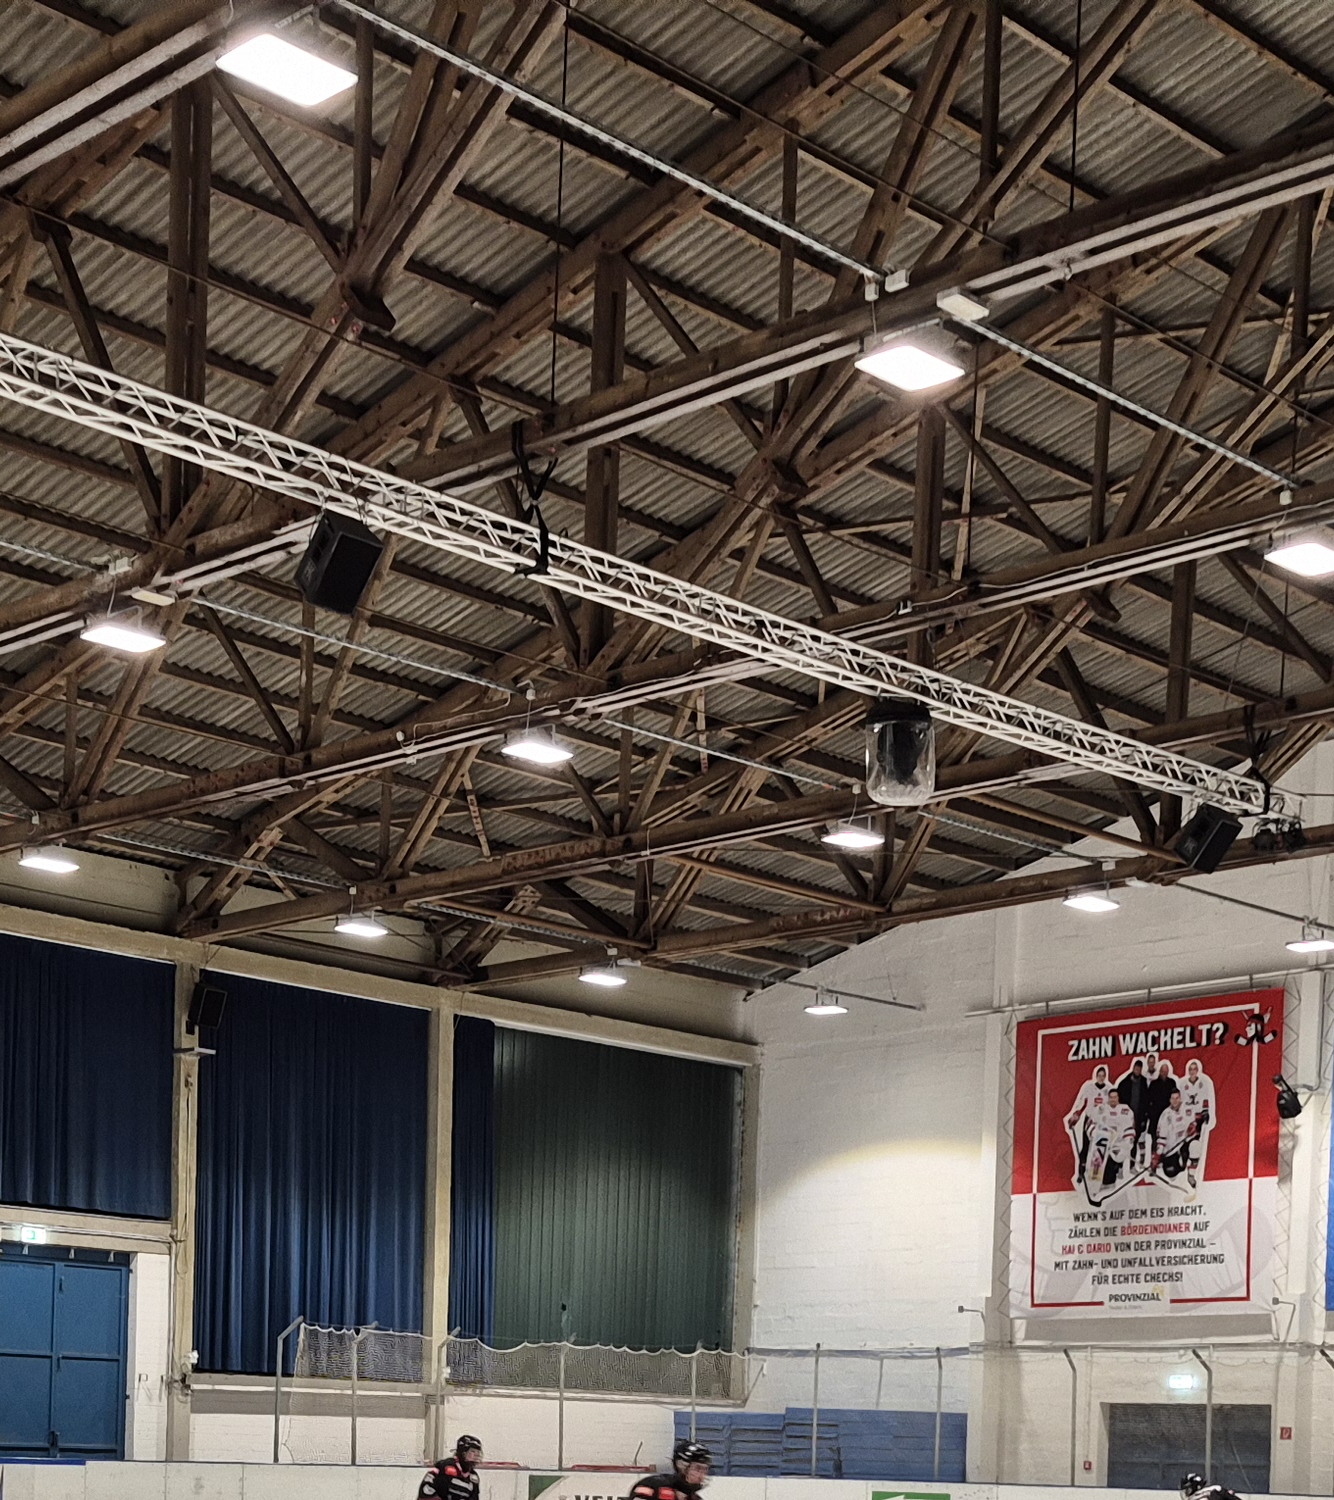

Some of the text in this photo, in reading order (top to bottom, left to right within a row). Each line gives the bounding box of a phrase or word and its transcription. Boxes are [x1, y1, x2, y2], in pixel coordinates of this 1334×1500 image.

[1068, 1022, 1225, 1061] ZAHN WACKELT?
[1109, 1209, 1126, 1221] AUF
[1129, 1208, 1148, 1220] DEM
[1150, 1207, 1165, 1218] EIS
[1068, 1221, 1210, 1239] ZÄHLEN DIE BÖRDEINDIANER AUF
[1086, 1243, 1112, 1254] DARIO
[1114, 1241, 1131, 1252] VON
[1134, 1240, 1152, 1251] DER
[1154, 1238, 1207, 1251] PROVINZIAL
[1054, 1261, 1069, 1271] MIT
[1072, 1259, 1098, 1270] ZAHN-
[1101, 1258, 1118, 1269] UND
[1092, 1272, 1109, 1285] FÜR
[1112, 1273, 1141, 1285] ECHTE
[1109, 1293, 1161, 1303] PROVINZIAL
